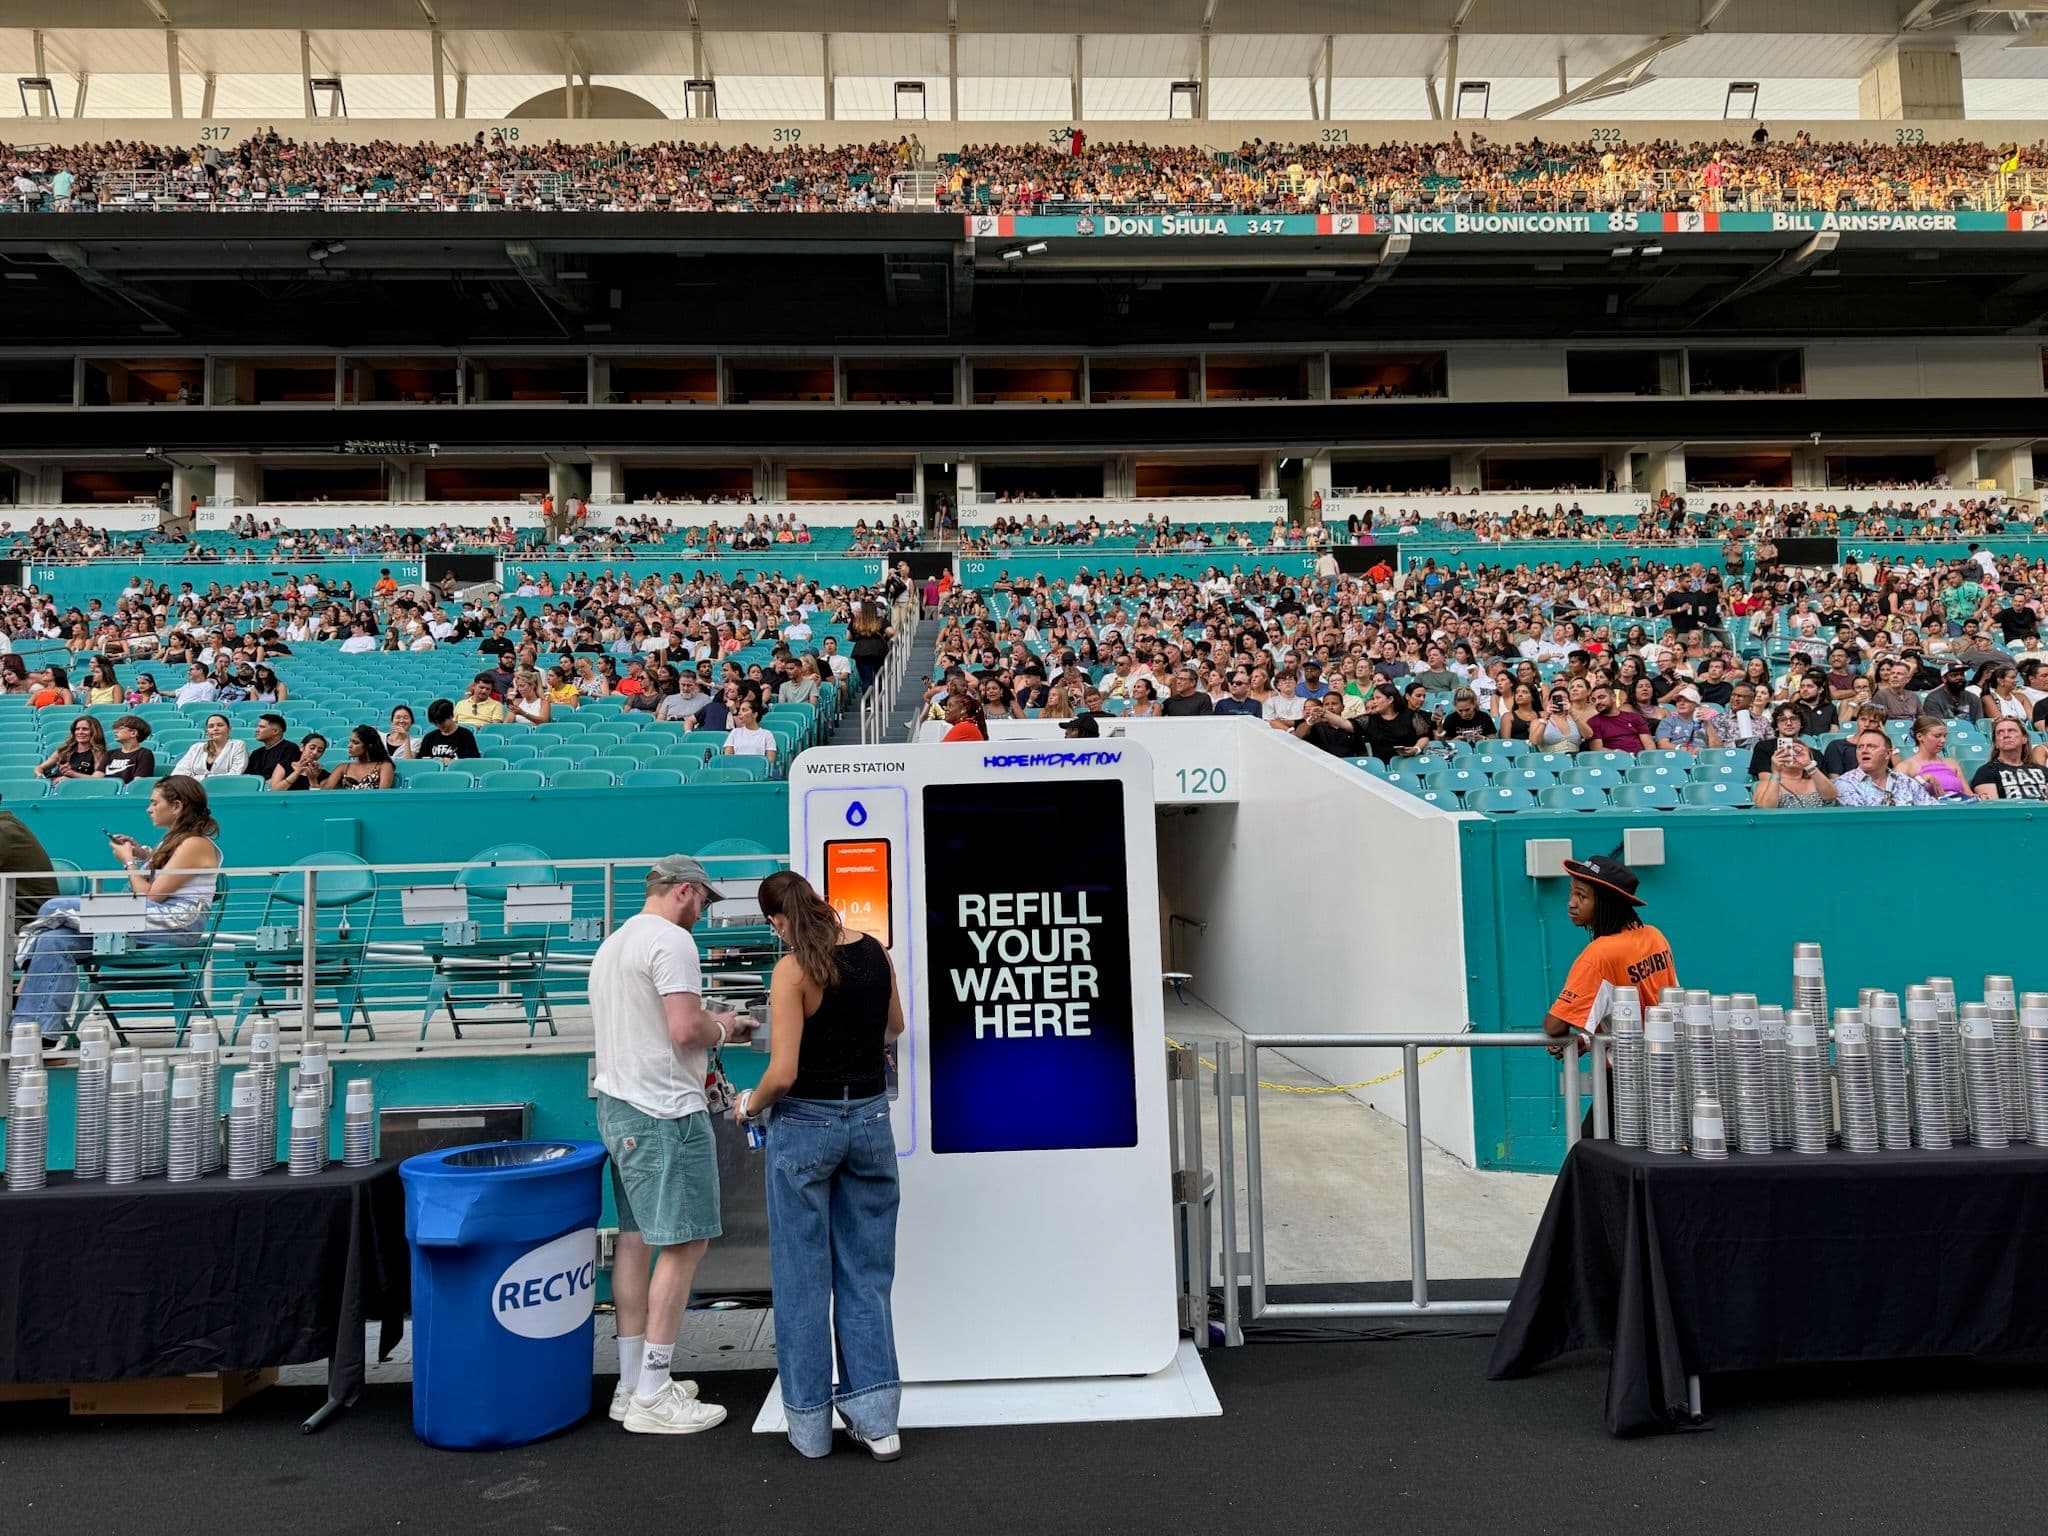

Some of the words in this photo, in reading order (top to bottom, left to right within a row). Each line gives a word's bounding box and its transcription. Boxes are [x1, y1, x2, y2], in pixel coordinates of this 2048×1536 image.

[201, 127, 230, 141] 317
[491, 127, 520, 141] 318
[772, 128, 801, 141] 319
[1321, 128, 1349, 142] 321
[1591, 128, 1621, 142] 322
[1895, 128, 1925, 141] 323
[1104, 215, 1152, 235] DON
[1161, 215, 1229, 235] SHULA
[1247, 220, 1285, 234] 347
[1394, 213, 1447, 233] NICK
[1454, 213, 1590, 233] BUONICONTI
[1608, 212, 1639, 231] 85
[1772, 213, 1815, 231] BILL
[1822, 212, 1957, 231] ARNSPARGER
[1325, 503, 1340, 511] 221
[1634, 499, 1649, 507] 221
[1688, 498, 1704, 506] 222
[905, 510, 920, 518] 219
[961, 509, 977, 518] 220
[1268, 505, 1284, 513] 220
[140, 513, 156, 522] 217
[200, 512, 215, 521] 218
[402, 567, 418, 576] 118
[506, 566, 523, 576] 119
[864, 564, 879, 574] 119
[966, 563, 984, 573] 120
[38, 571, 55, 580] 118
[807, 763, 851, 775] WATER
[852, 762, 905, 773] STATION
[1175, 768, 1227, 794] 120
[1999, 768, 2046, 787] DAD
[851, 901, 871, 913] 0.4
[958, 891, 1103, 928] REFILL
[967, 928, 1092, 964] YOUR
[1627, 950, 1673, 984] SECURI
[949, 964, 1100, 1003] WATER
[974, 1002, 1092, 1039] HERE
